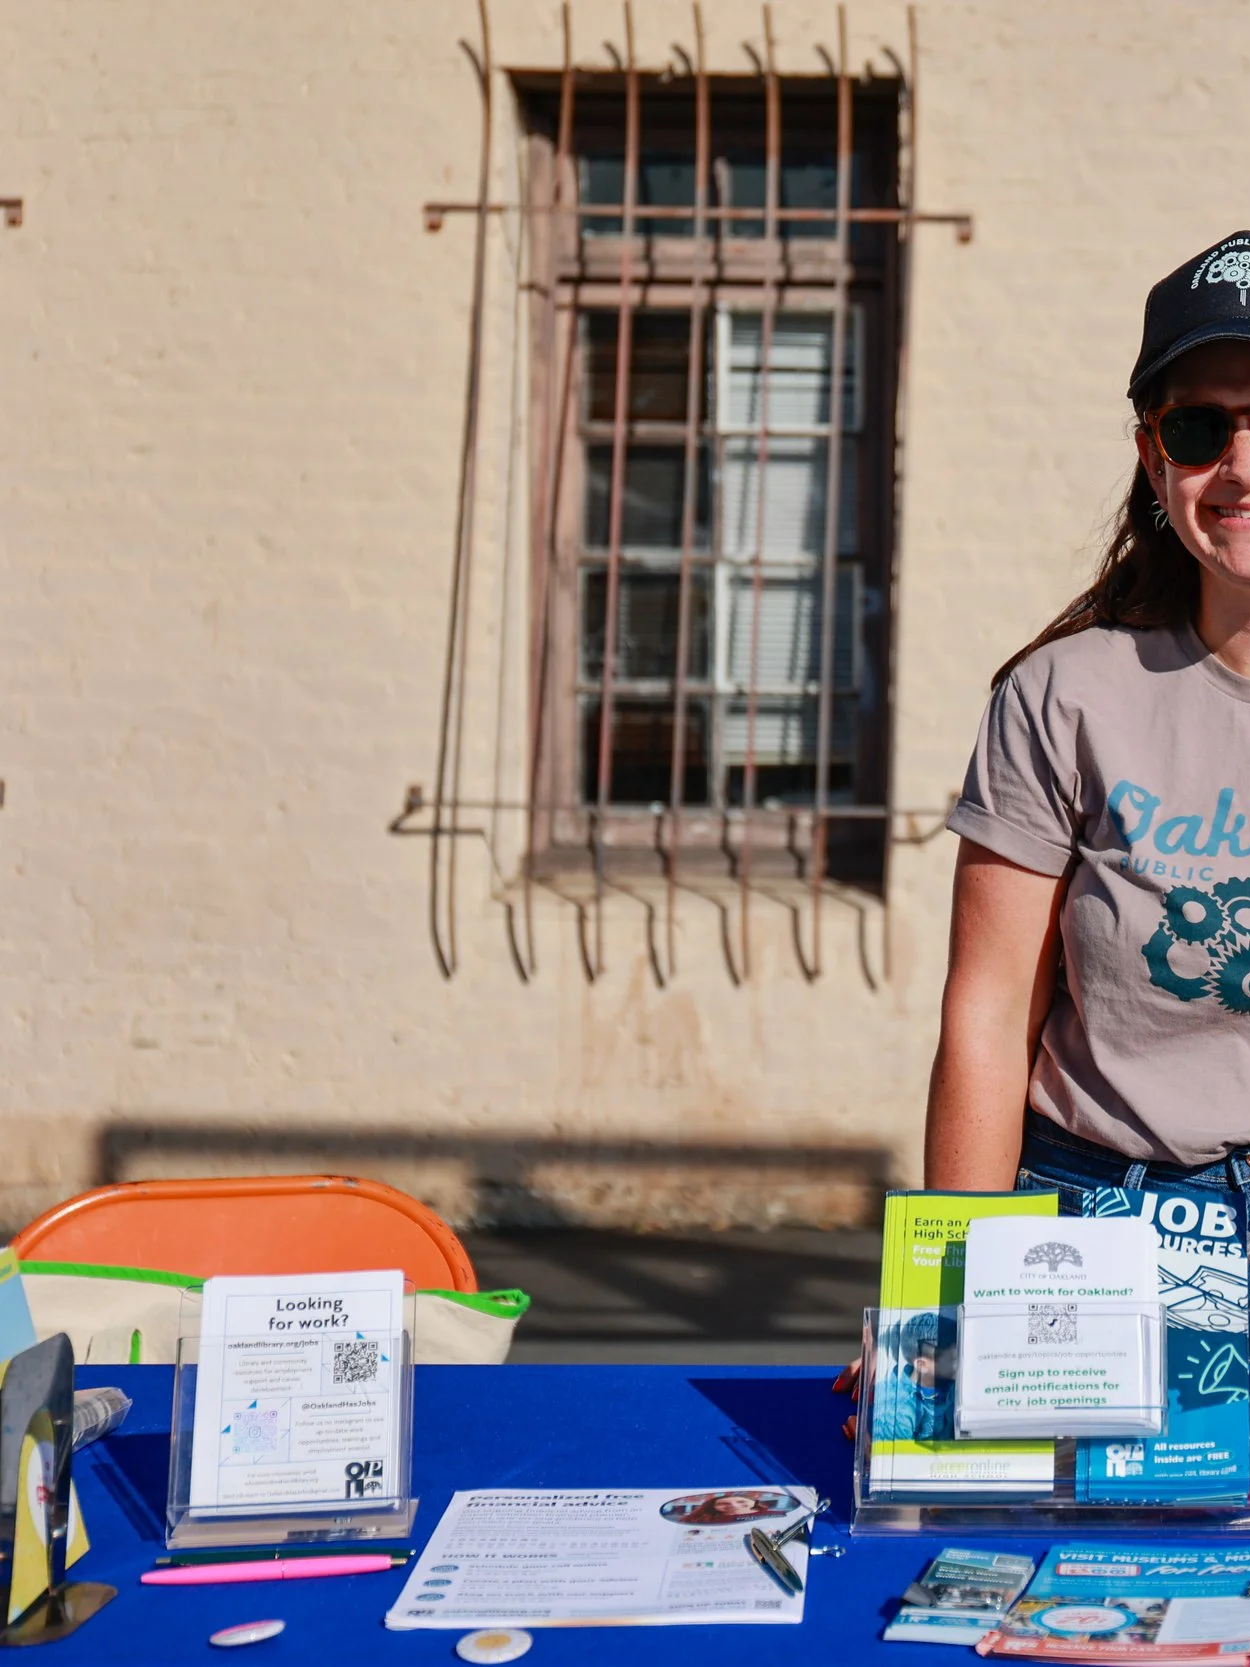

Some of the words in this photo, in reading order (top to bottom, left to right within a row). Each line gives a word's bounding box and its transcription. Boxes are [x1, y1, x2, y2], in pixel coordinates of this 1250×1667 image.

[1191, 250, 1219, 290] OAKLAND
[1120, 856, 1214, 881] PUBLIC
[1130, 1191, 1238, 1238] JOB
[914, 1217, 944, 1227] Earn
[914, 1229, 943, 1240] High
[913, 1244, 941, 1254] Free
[1158, 1234, 1242, 1258] URCES
[912, 1257, 942, 1266] Your
[973, 1288, 1005, 1298] Want
[1058, 1288, 1074, 1296] for
[1077, 1288, 1133, 1296] Oakland?
[276, 1296, 343, 1313] Looking
[268, 1316, 294, 1330] for
[298, 1314, 349, 1329] work?
[228, 1339, 319, 1350] oaklandlibrary.org/jobs
[998, 1369, 1025, 1379] Sign
[1028, 1370, 1044, 1378] up
[1062, 1367, 1107, 1376] receive
[984, 1383, 1019, 1394] email
[1022, 1382, 1100, 1391] notifications
[1102, 1381, 1120, 1390] for
[302, 1400, 376, 1410] @OaklandHasJobs
[1027, 1397, 1047, 1407] job
[1049, 1396, 1106, 1408] openings
[1154, 1443, 1167, 1451] All
[1168, 1442, 1215, 1450] resources
[1186, 1454, 1203, 1462] are
[1207, 1451, 1230, 1461] FREE
[1059, 1552, 1108, 1562] VISIT
[1112, 1553, 1199, 1564] MUSEUMS
[1203, 1553, 1218, 1563] &
[1146, 1564, 1198, 1576] for
